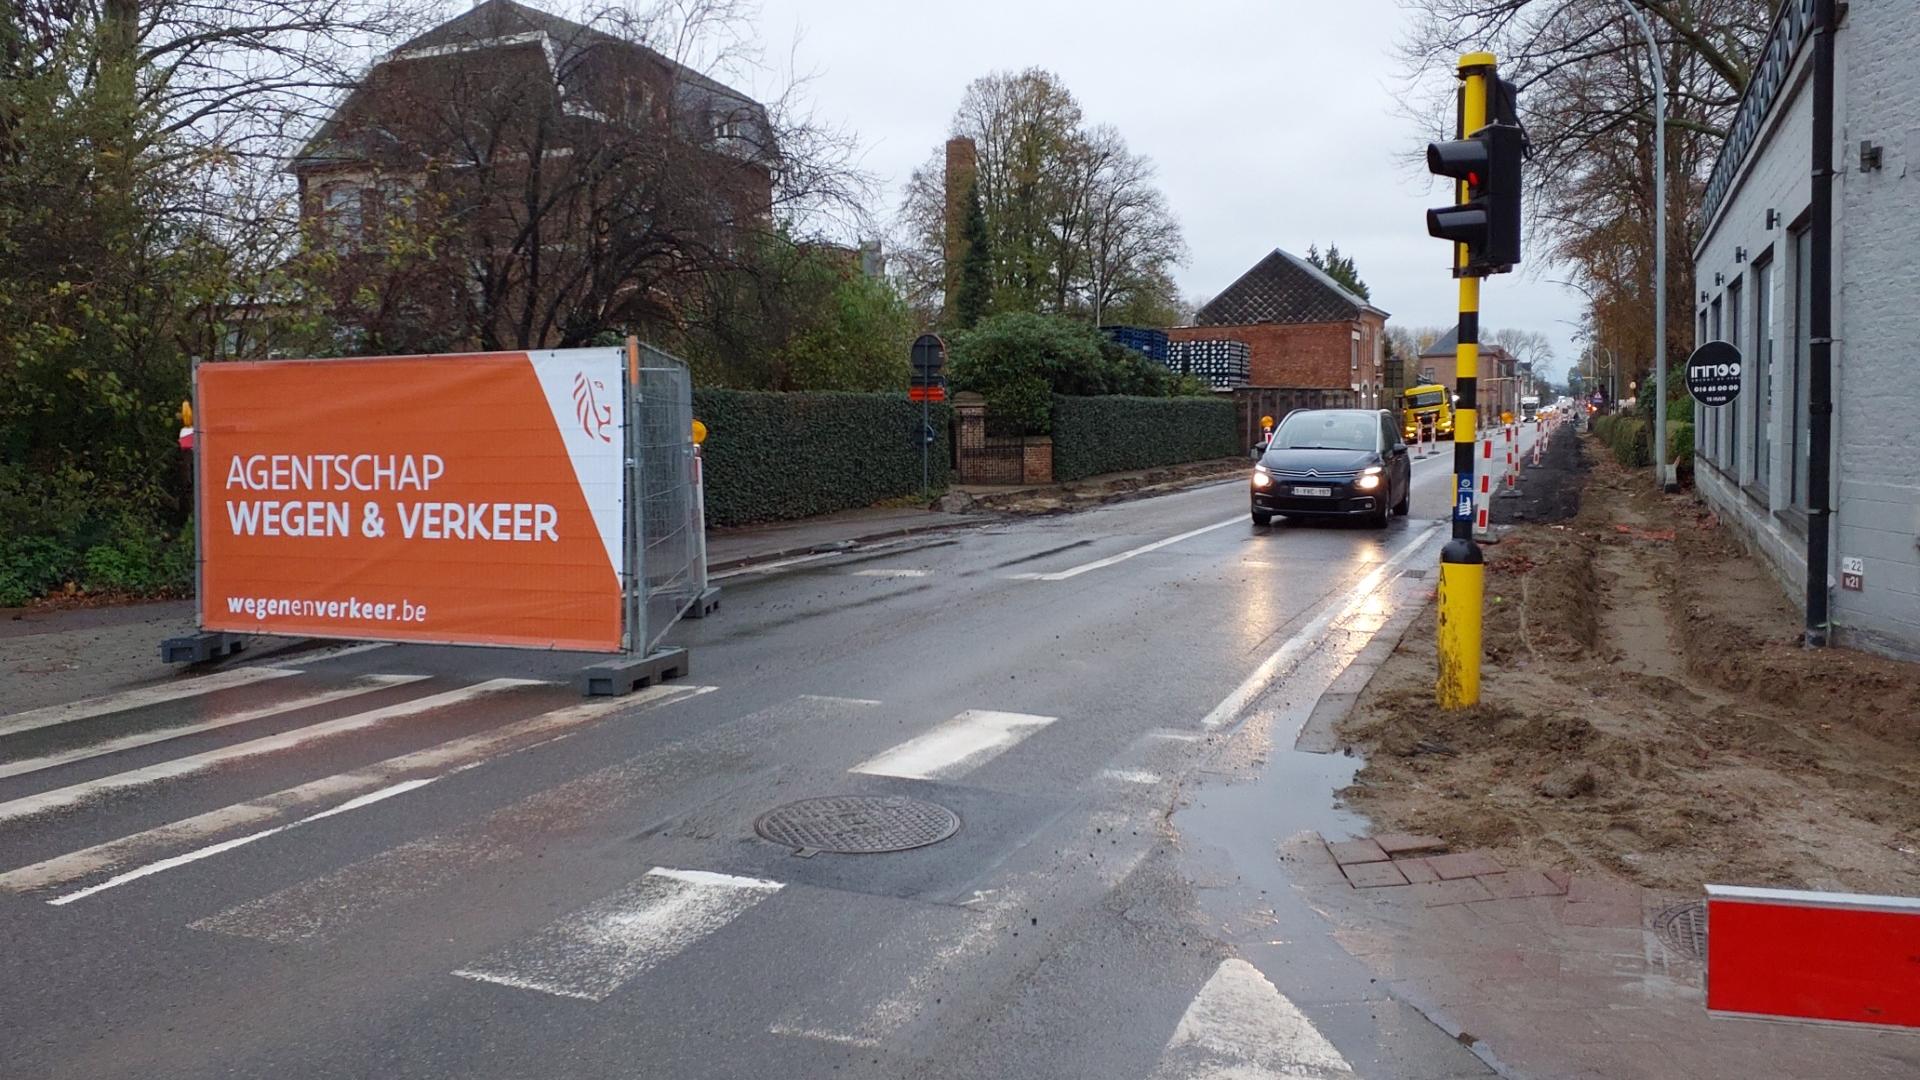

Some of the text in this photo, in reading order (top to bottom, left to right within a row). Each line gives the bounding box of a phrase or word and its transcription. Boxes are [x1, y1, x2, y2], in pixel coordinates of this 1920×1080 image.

[226, 454, 444, 491] AGENTSCHAP
[226, 500, 559, 542] WEGEN & VERKEER
[1851, 560, 1861, 572] 22
[227, 596, 426, 622] wegenenverkeer.be
